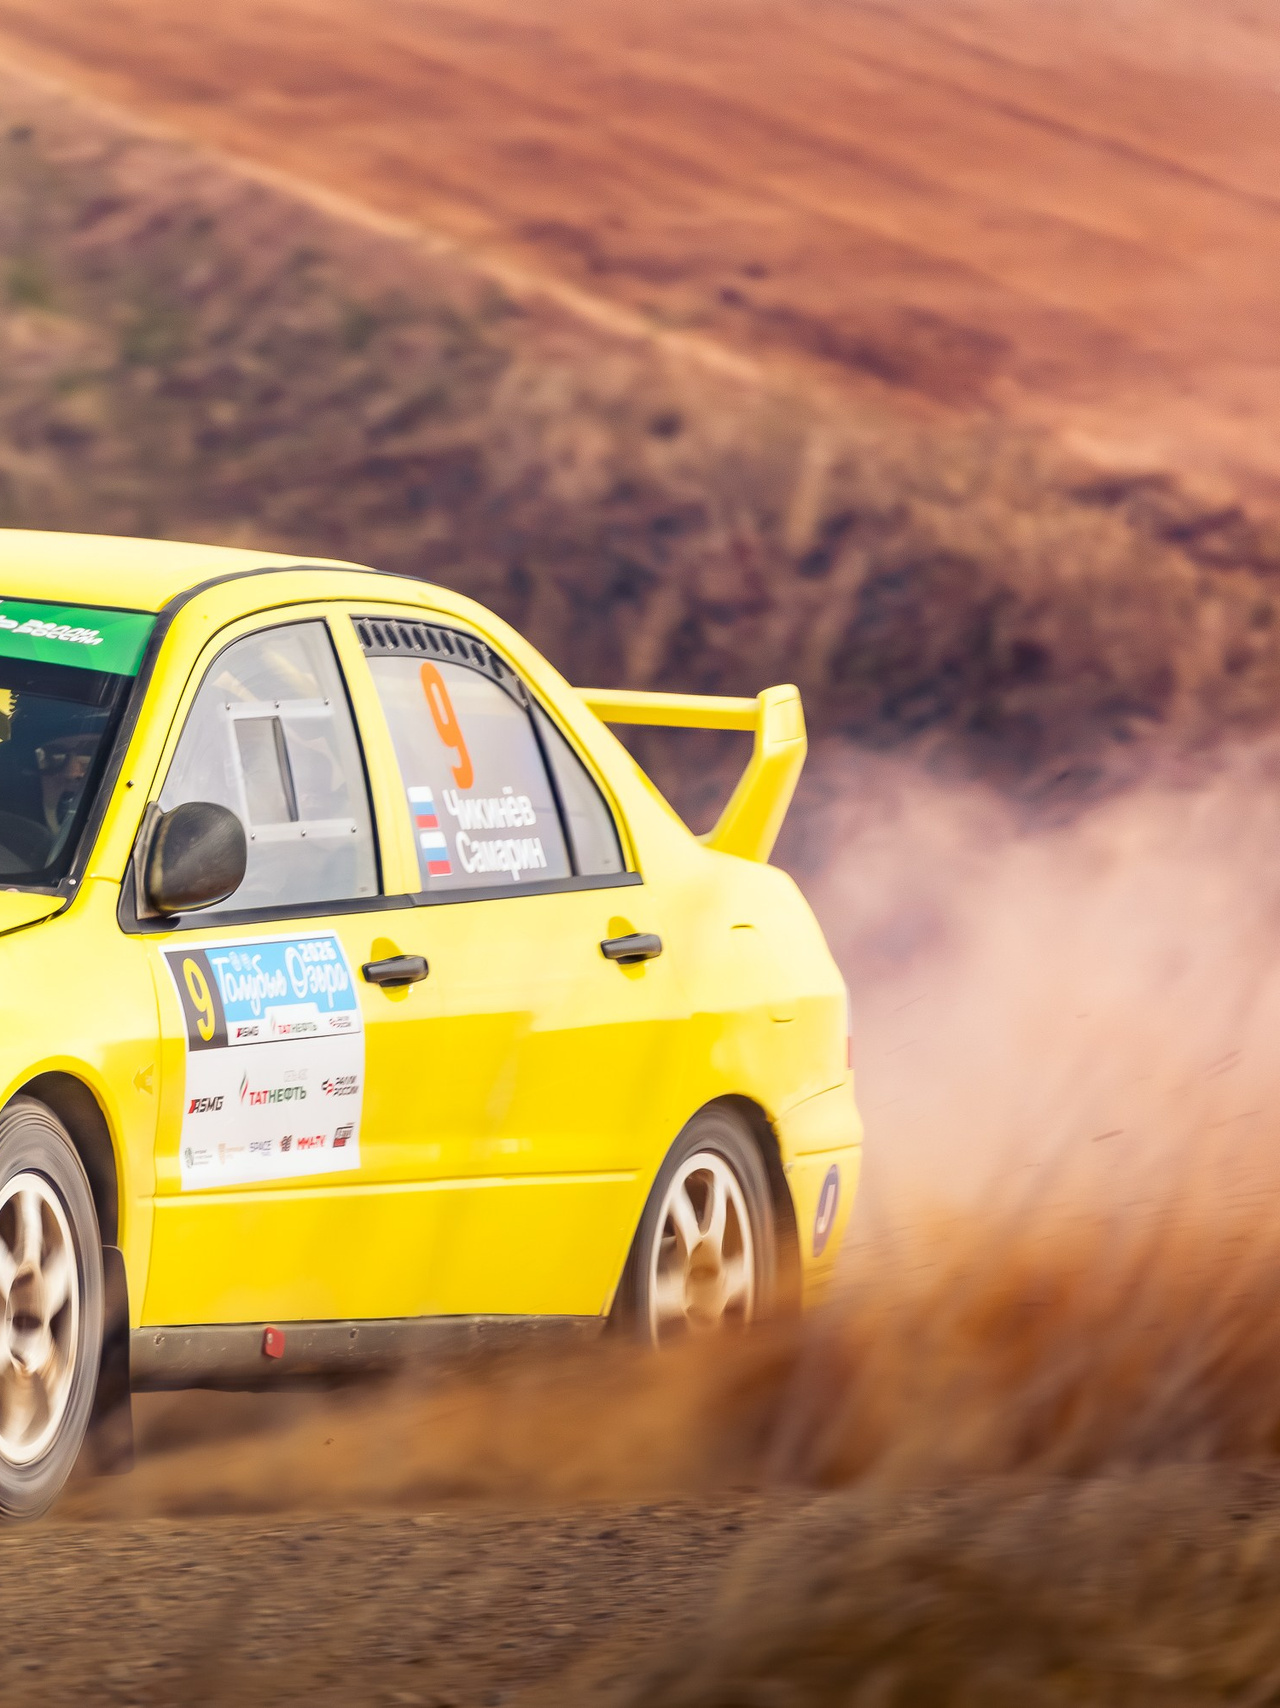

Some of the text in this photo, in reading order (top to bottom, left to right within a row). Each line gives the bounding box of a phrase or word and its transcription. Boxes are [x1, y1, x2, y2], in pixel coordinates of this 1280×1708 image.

[419, 661, 474, 789] 9
[455, 830, 547, 881] Самарин
[182, 957, 216, 1042] 9
[249, 1086, 307, 1106] ТАТНЕФТЬ
